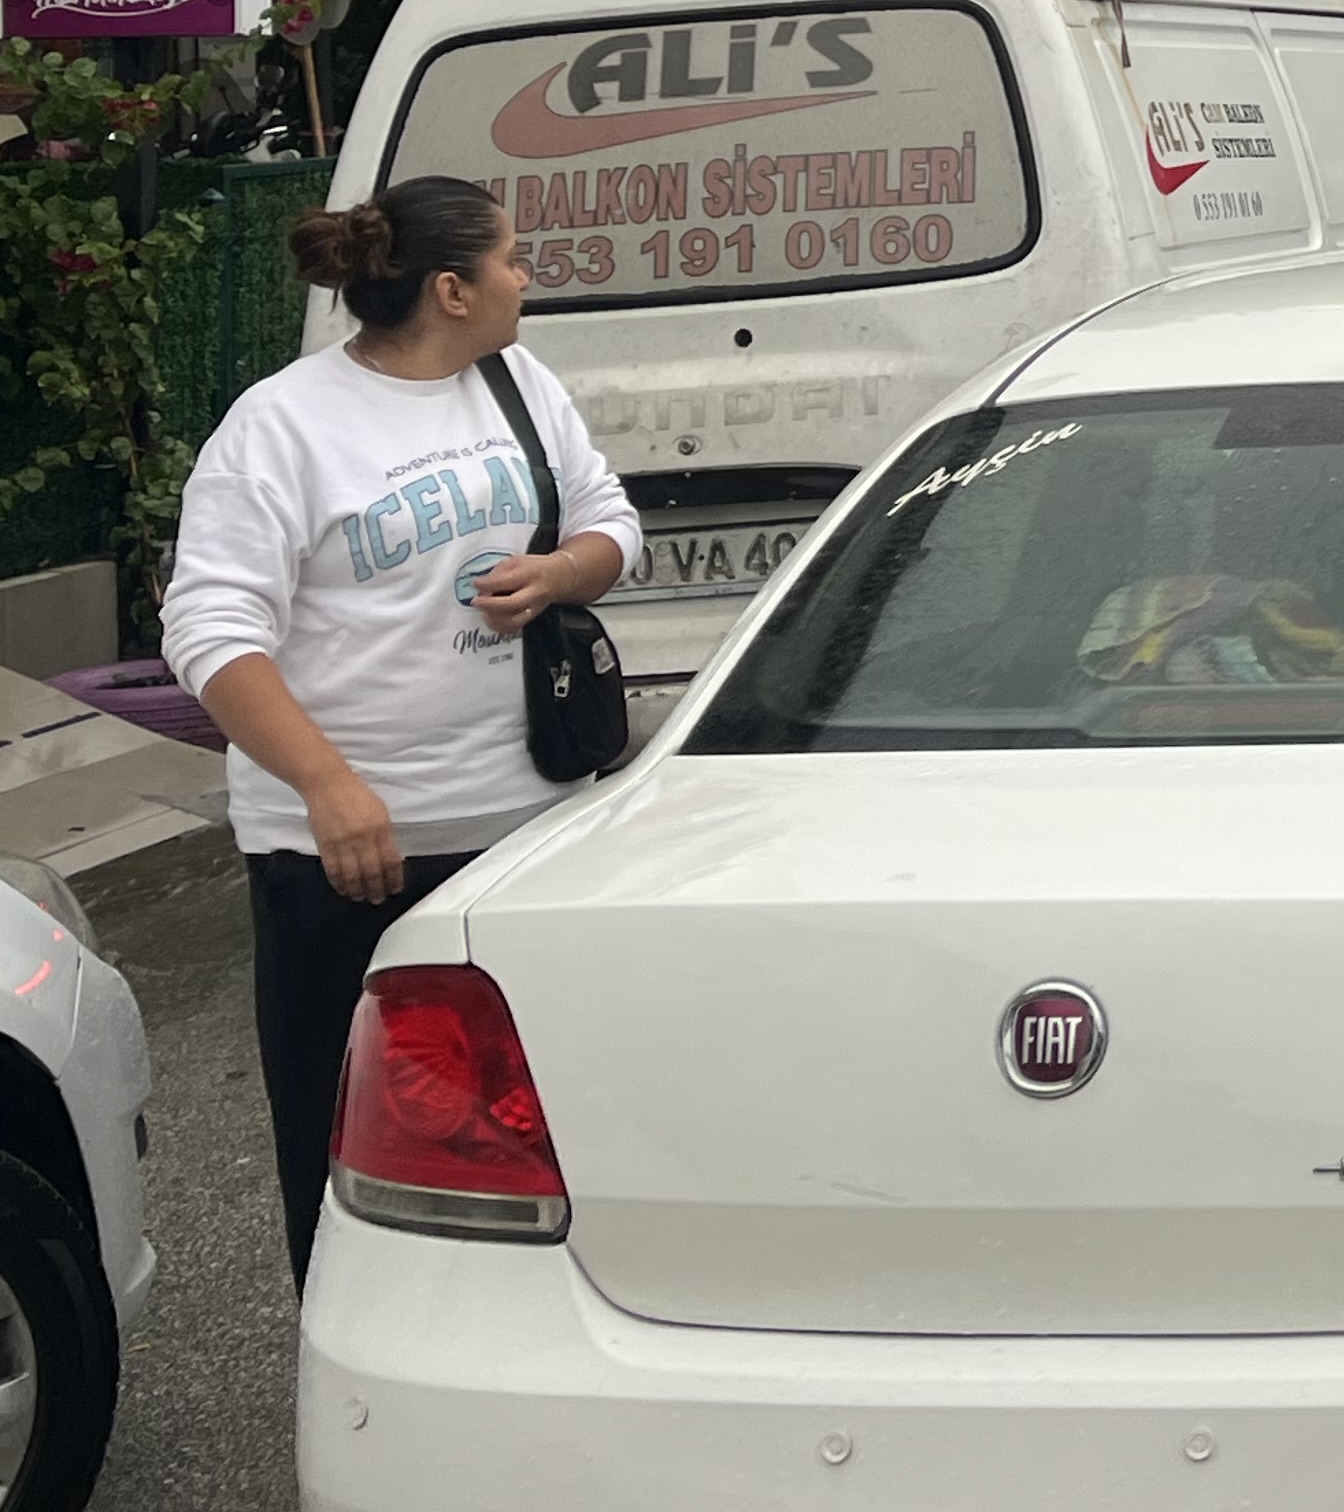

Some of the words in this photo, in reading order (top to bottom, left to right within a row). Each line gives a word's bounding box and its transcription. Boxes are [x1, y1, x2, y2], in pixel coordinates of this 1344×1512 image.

[514, 161, 689, 234] BALKON
[702, 130, 977, 220] SİSTEMLERİ
[640, 222, 758, 280] 191
[784, 212, 954, 271] 0160
[668, 537, 736, 584] VA
[1022, 1015, 1083, 1065] FIAT
